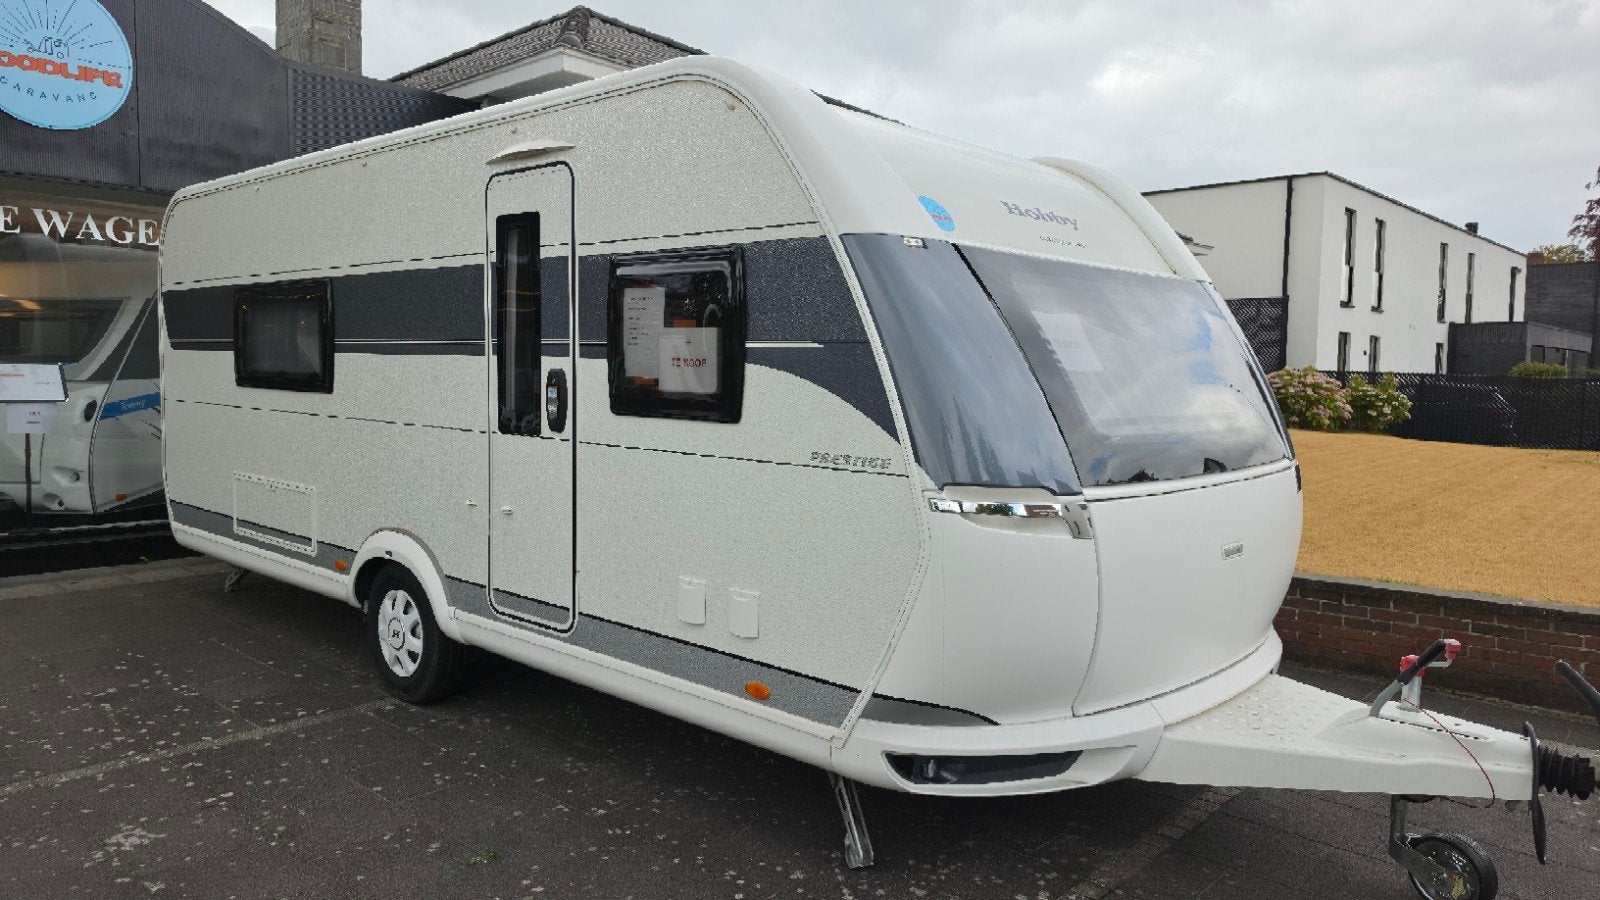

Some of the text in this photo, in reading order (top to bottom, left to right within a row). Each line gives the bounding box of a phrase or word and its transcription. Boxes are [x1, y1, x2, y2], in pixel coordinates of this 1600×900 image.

[0, 75, 97, 102] CARAVANS
[0, 205, 21, 234] E
[1000, 200, 1078, 231] Hobby
[671, 357, 707, 368] TE KOOP
[810, 451, 892, 470] PRESTIGE
